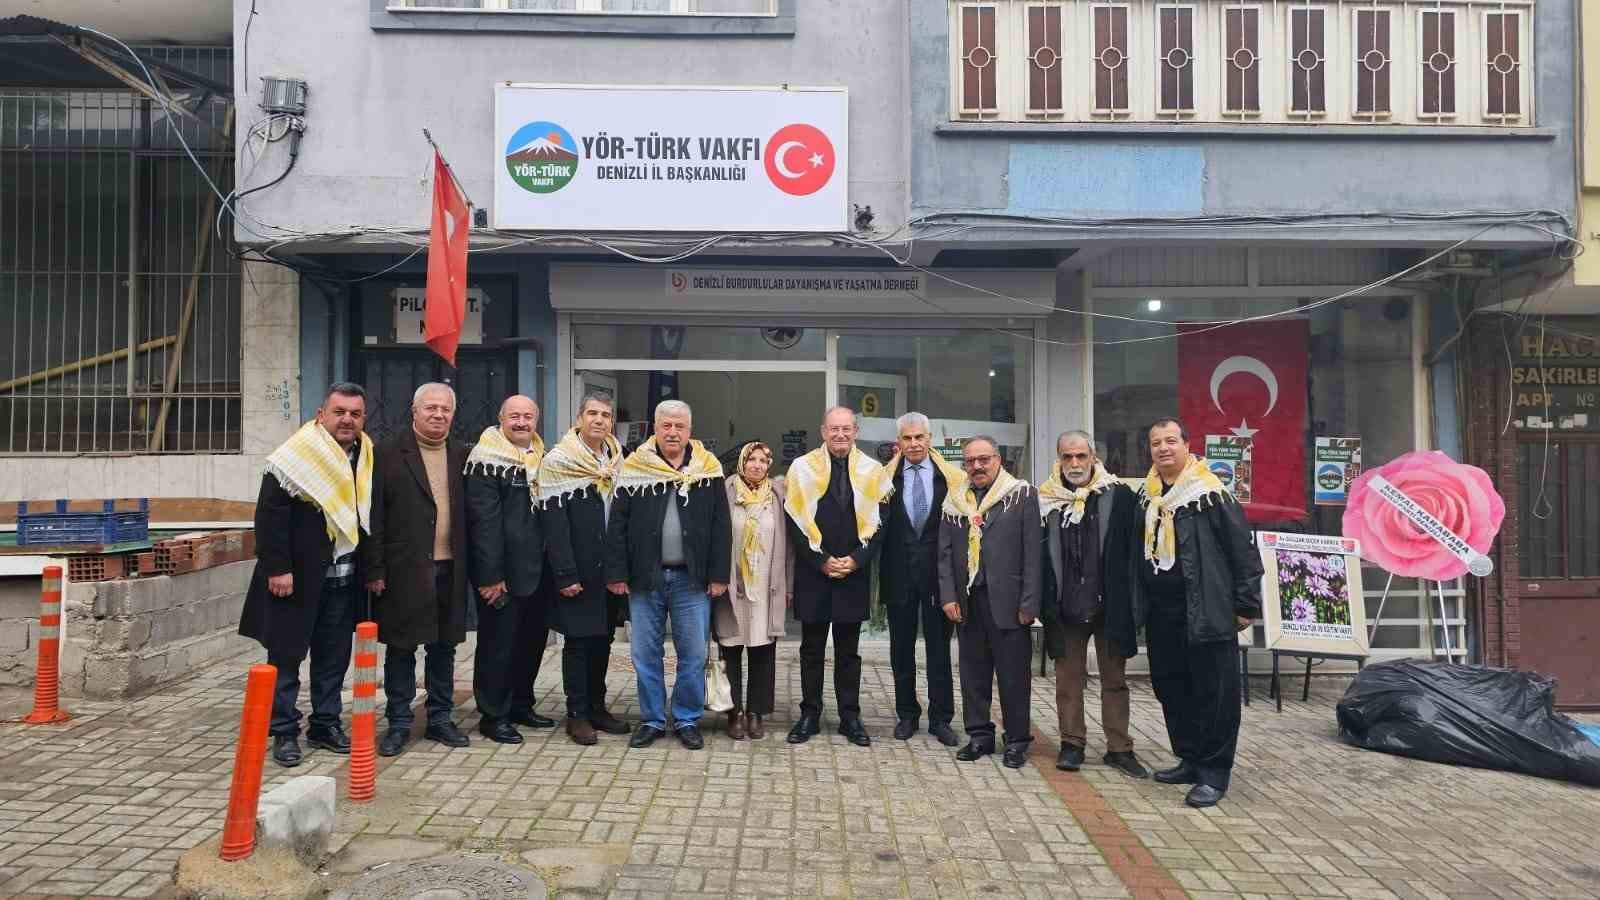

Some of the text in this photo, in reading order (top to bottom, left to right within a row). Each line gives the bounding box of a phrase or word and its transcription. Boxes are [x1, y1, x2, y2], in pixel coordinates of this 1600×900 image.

[582, 132, 760, 161] YÖR-TÜRK VAKFI
[514, 163, 571, 177] YÖR-TÜRK
[597, 163, 746, 183] DENİZLİ İL BAŞKANLIĞI
[532, 178, 554, 187] VAKFI
[1512, 368, 1600, 384] SAKİRLE
[1414, 508, 1471, 554] KARABABA
